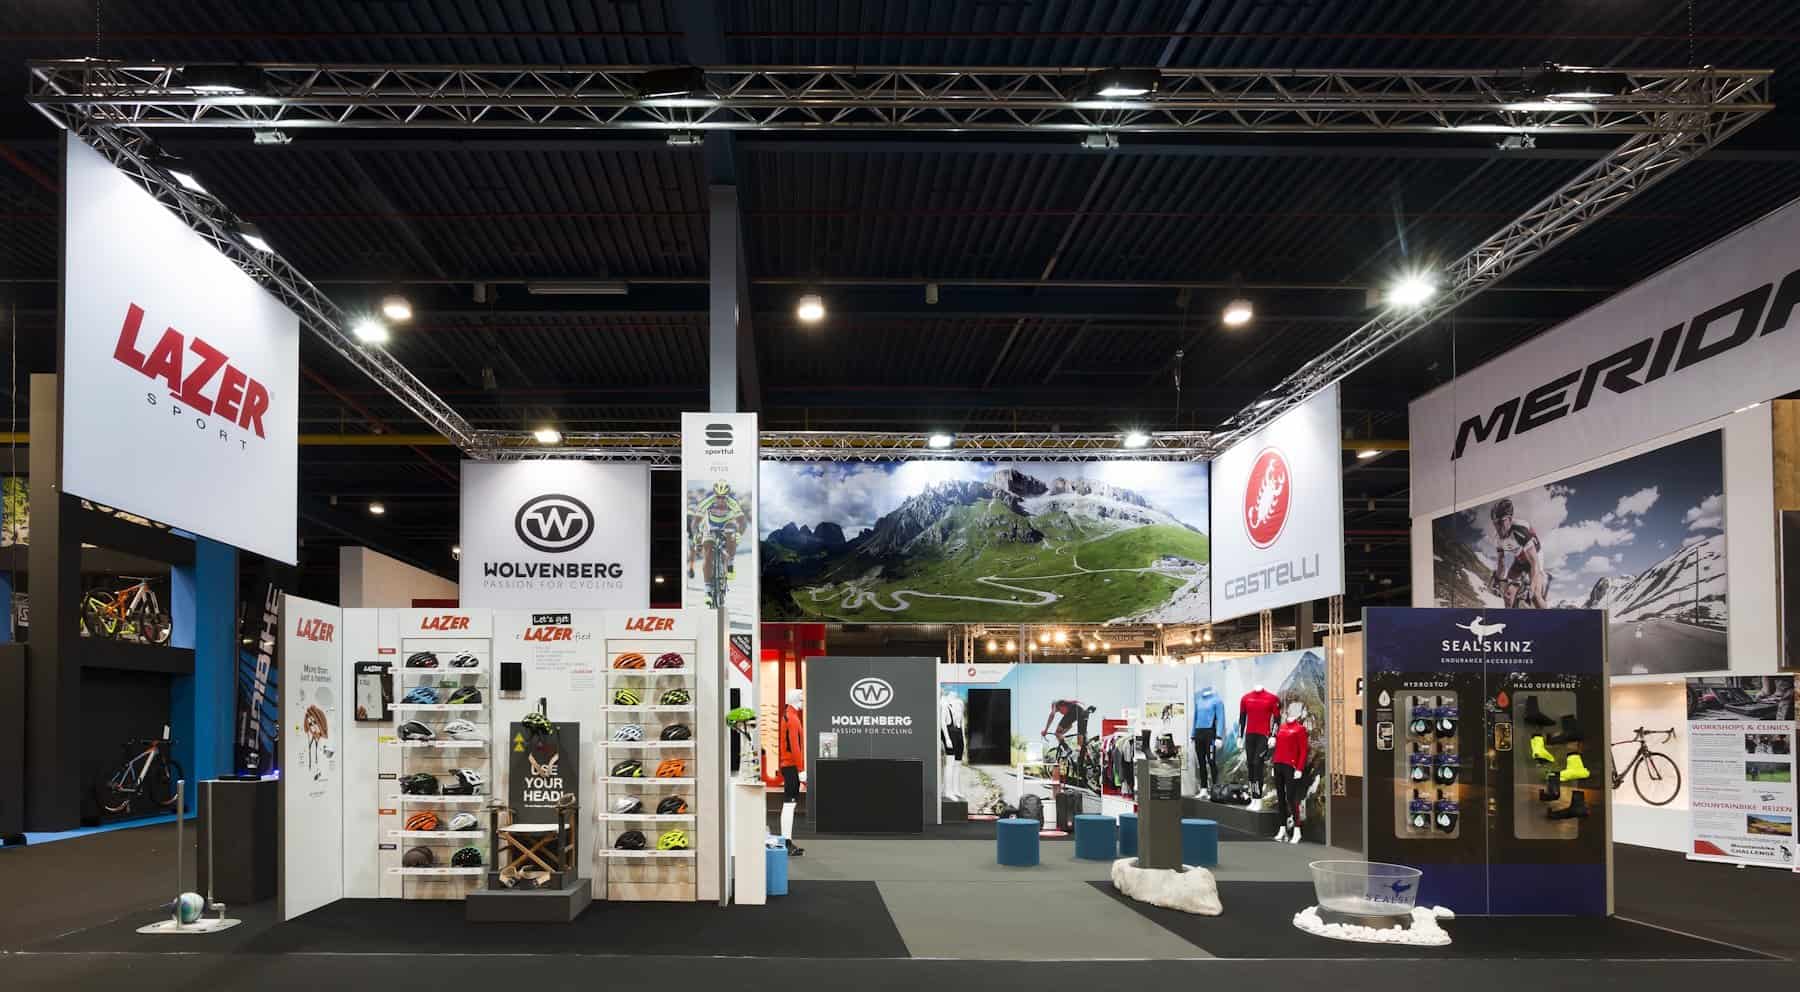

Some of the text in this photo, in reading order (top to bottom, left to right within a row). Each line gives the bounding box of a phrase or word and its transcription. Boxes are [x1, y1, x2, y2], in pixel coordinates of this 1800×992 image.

[113, 302, 270, 440] LAZER
[147, 392, 247, 450] SPORT
[484, 562, 624, 578] WOLVENBERG
[484, 580, 624, 589] PASSION FOR CYCLING
[421, 615, 470, 630] LAZER
[625, 616, 675, 632] LAZER
[296, 617, 335, 642] LAZER
[523, 626, 573, 642] LAZER
[1442, 640, 1532, 652] SEALSKINZ
[831, 715, 913, 726] WOLVENBERG
[1692, 723, 1744, 731] WORKSHOPS
[832, 727, 913, 735] PASSION FOR CYCLING
[525, 777, 563, 789] YOUR
[1692, 801, 1757, 811] MOUNTAINBIKE
